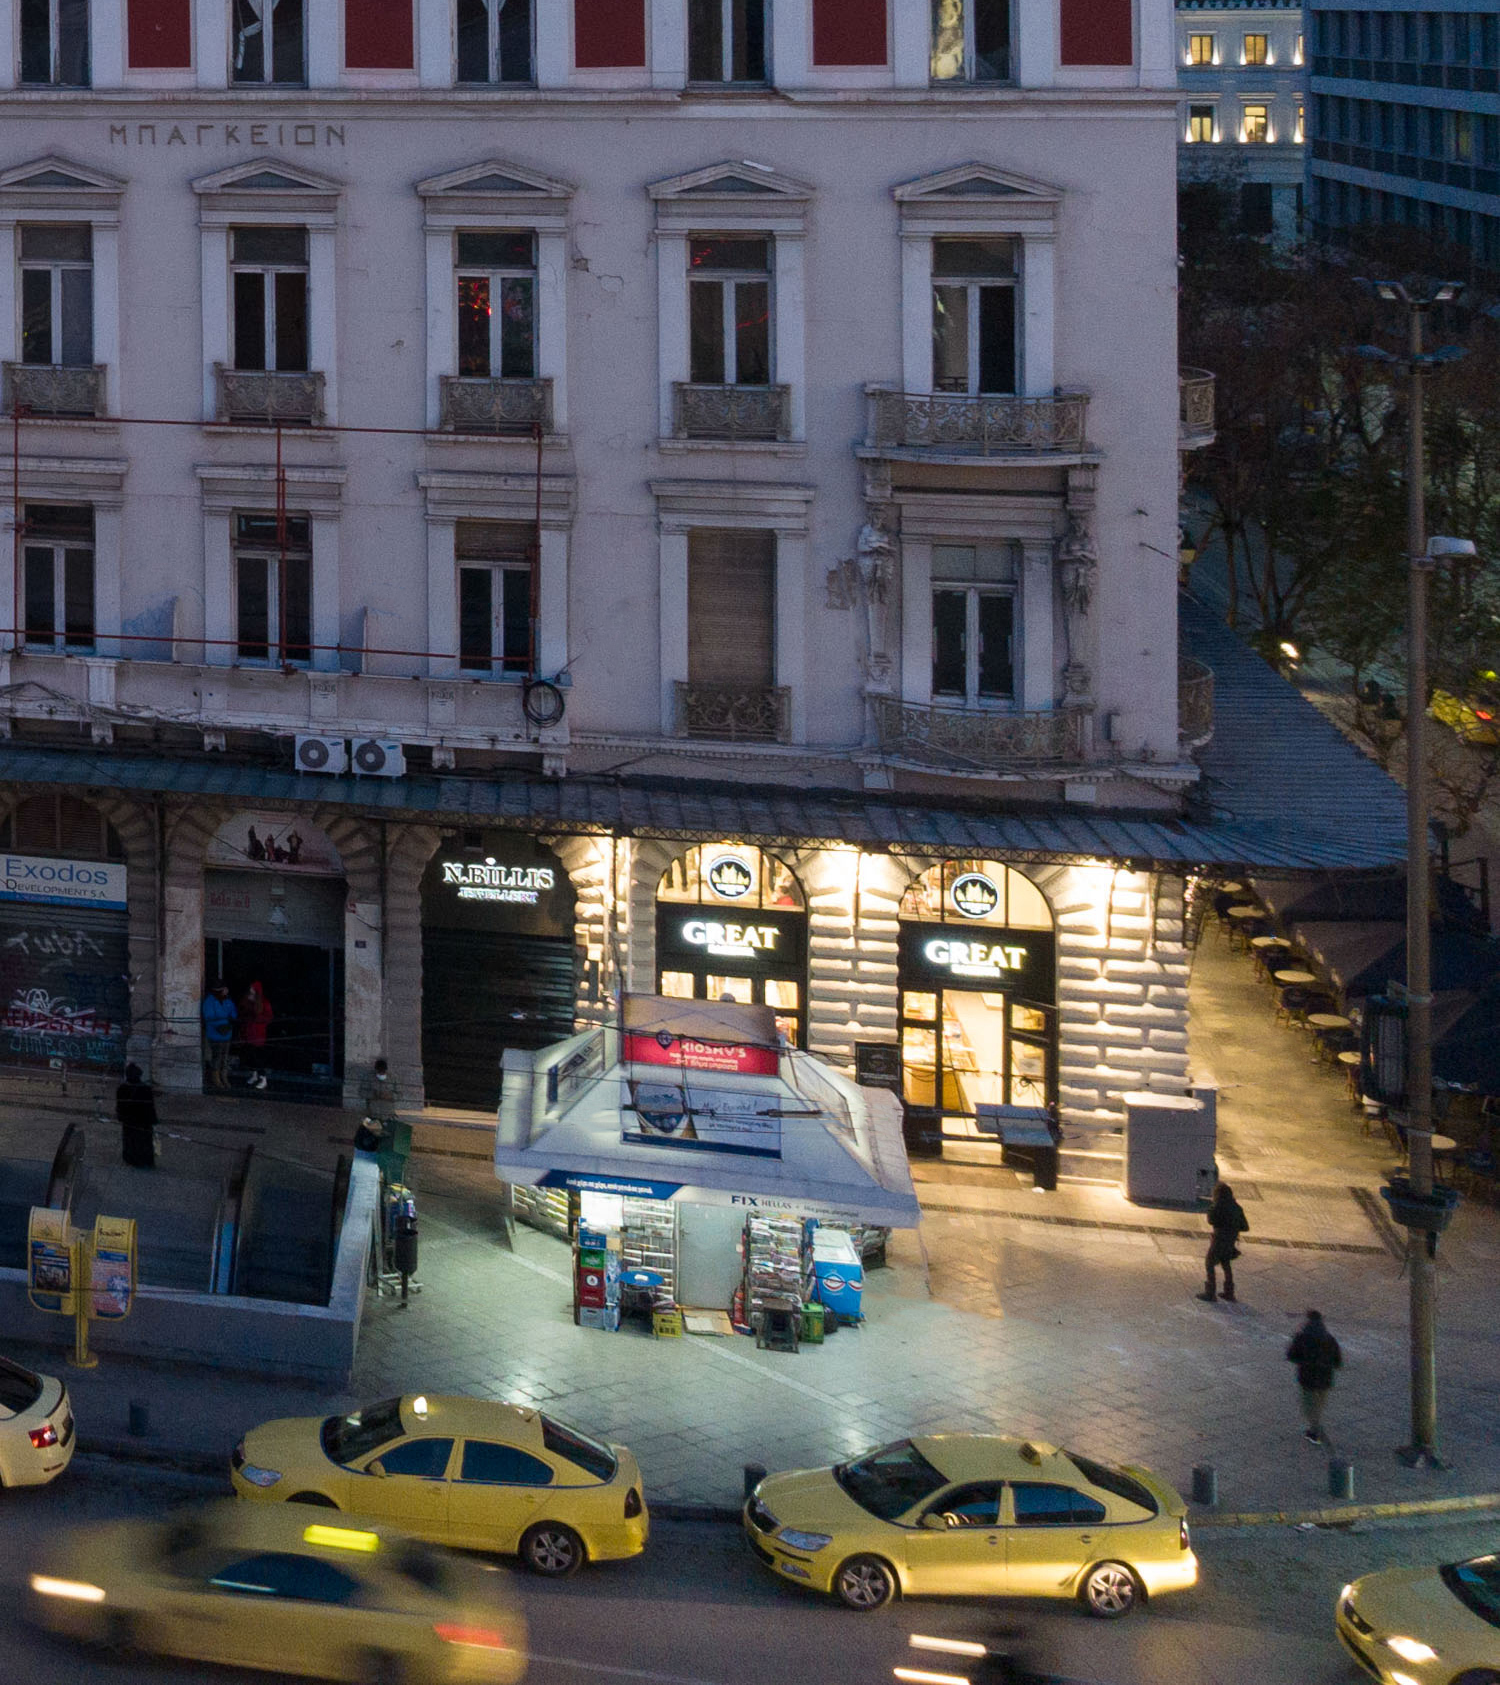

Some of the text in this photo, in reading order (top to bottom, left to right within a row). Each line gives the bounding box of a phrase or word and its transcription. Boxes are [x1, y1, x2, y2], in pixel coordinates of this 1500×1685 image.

[109, 123, 347, 147] ΜΠΑΓΚΕΙΟΝ
[5, 857, 108, 886] Exodos
[682, 921, 781, 950] GREAT
[924, 940, 1028, 970] GREAT
[731, 1194, 758, 1207] FIX
